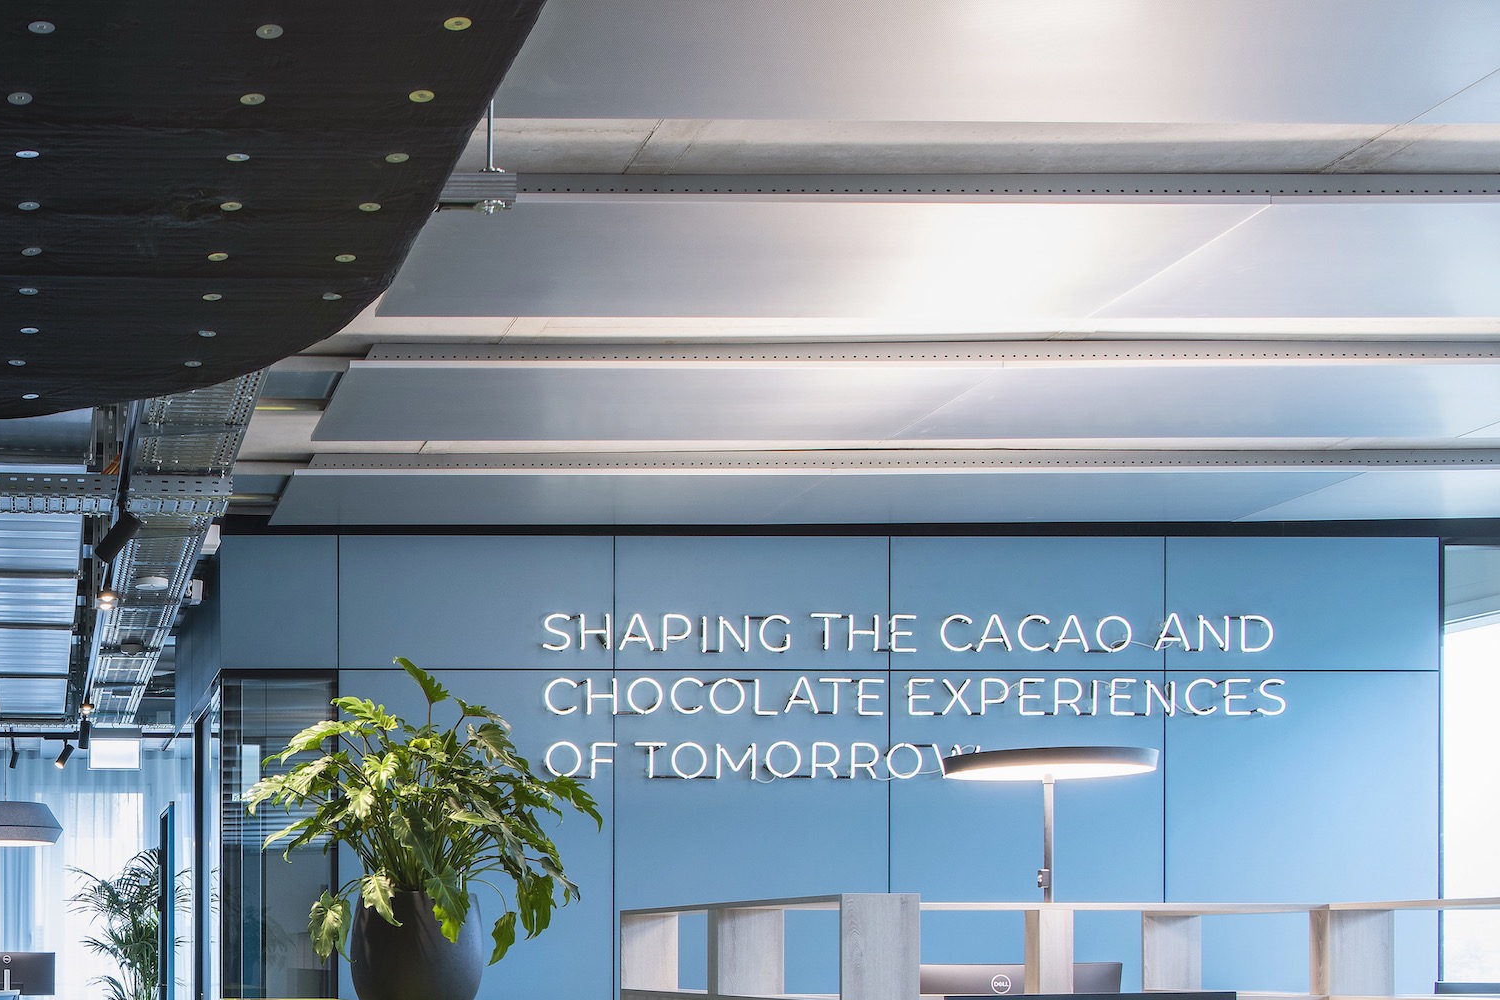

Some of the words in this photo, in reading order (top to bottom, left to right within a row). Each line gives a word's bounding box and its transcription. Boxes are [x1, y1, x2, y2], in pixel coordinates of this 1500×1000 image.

[542, 612, 791, 653] SHAPING
[810, 613, 917, 653] THE
[939, 613, 1132, 653] CACAO
[1153, 612, 1274, 653] AND
[544, 676, 885, 716] CHOCOLATE
[907, 677, 1287, 717] EXPERIENCES
[545, 741, 618, 779] OF
